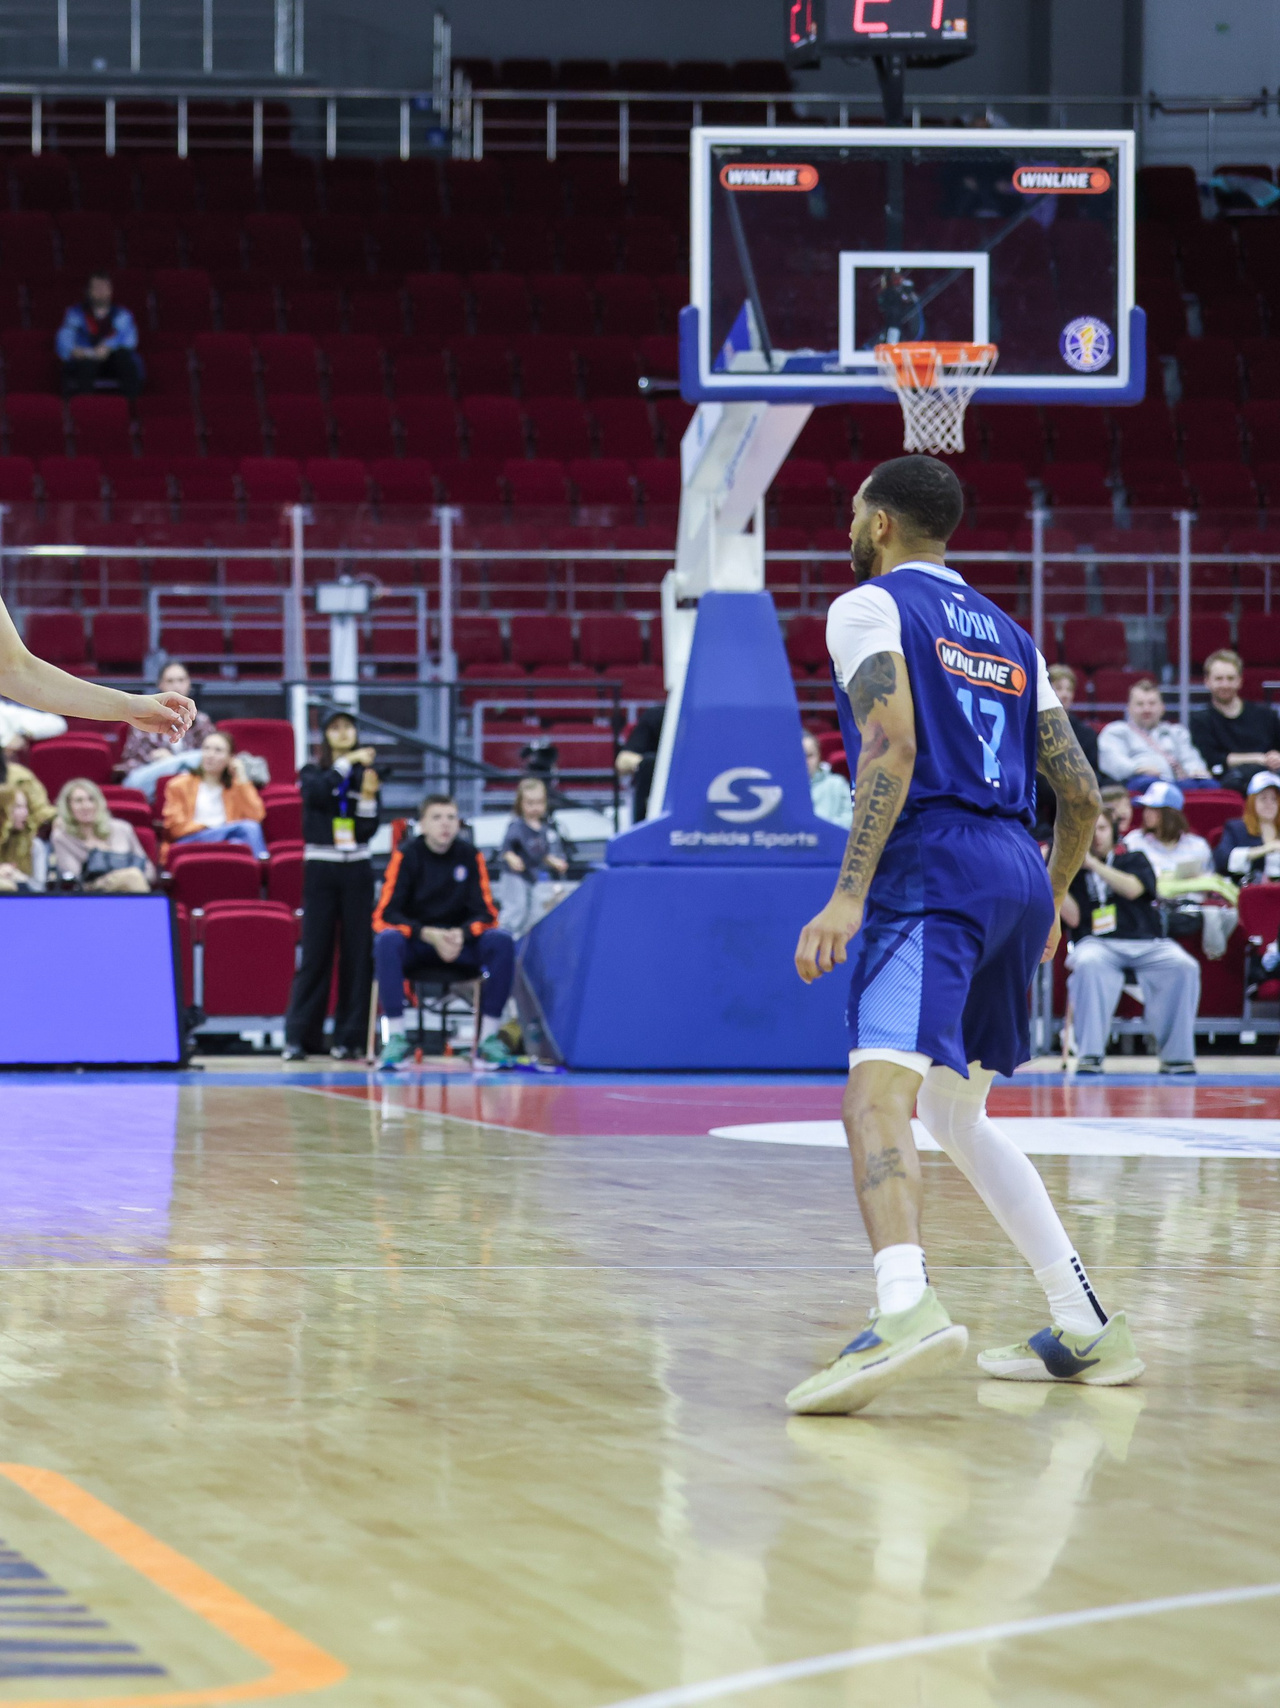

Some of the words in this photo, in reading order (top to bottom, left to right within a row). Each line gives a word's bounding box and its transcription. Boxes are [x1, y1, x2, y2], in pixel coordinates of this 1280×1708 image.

[727, 168, 798, 186] WINLINE
[1020, 172, 1090, 189] WINLINE
[940, 599, 1000, 644] MOON
[956, 687, 1006, 783] 17
[752, 830, 819, 849] Sports
